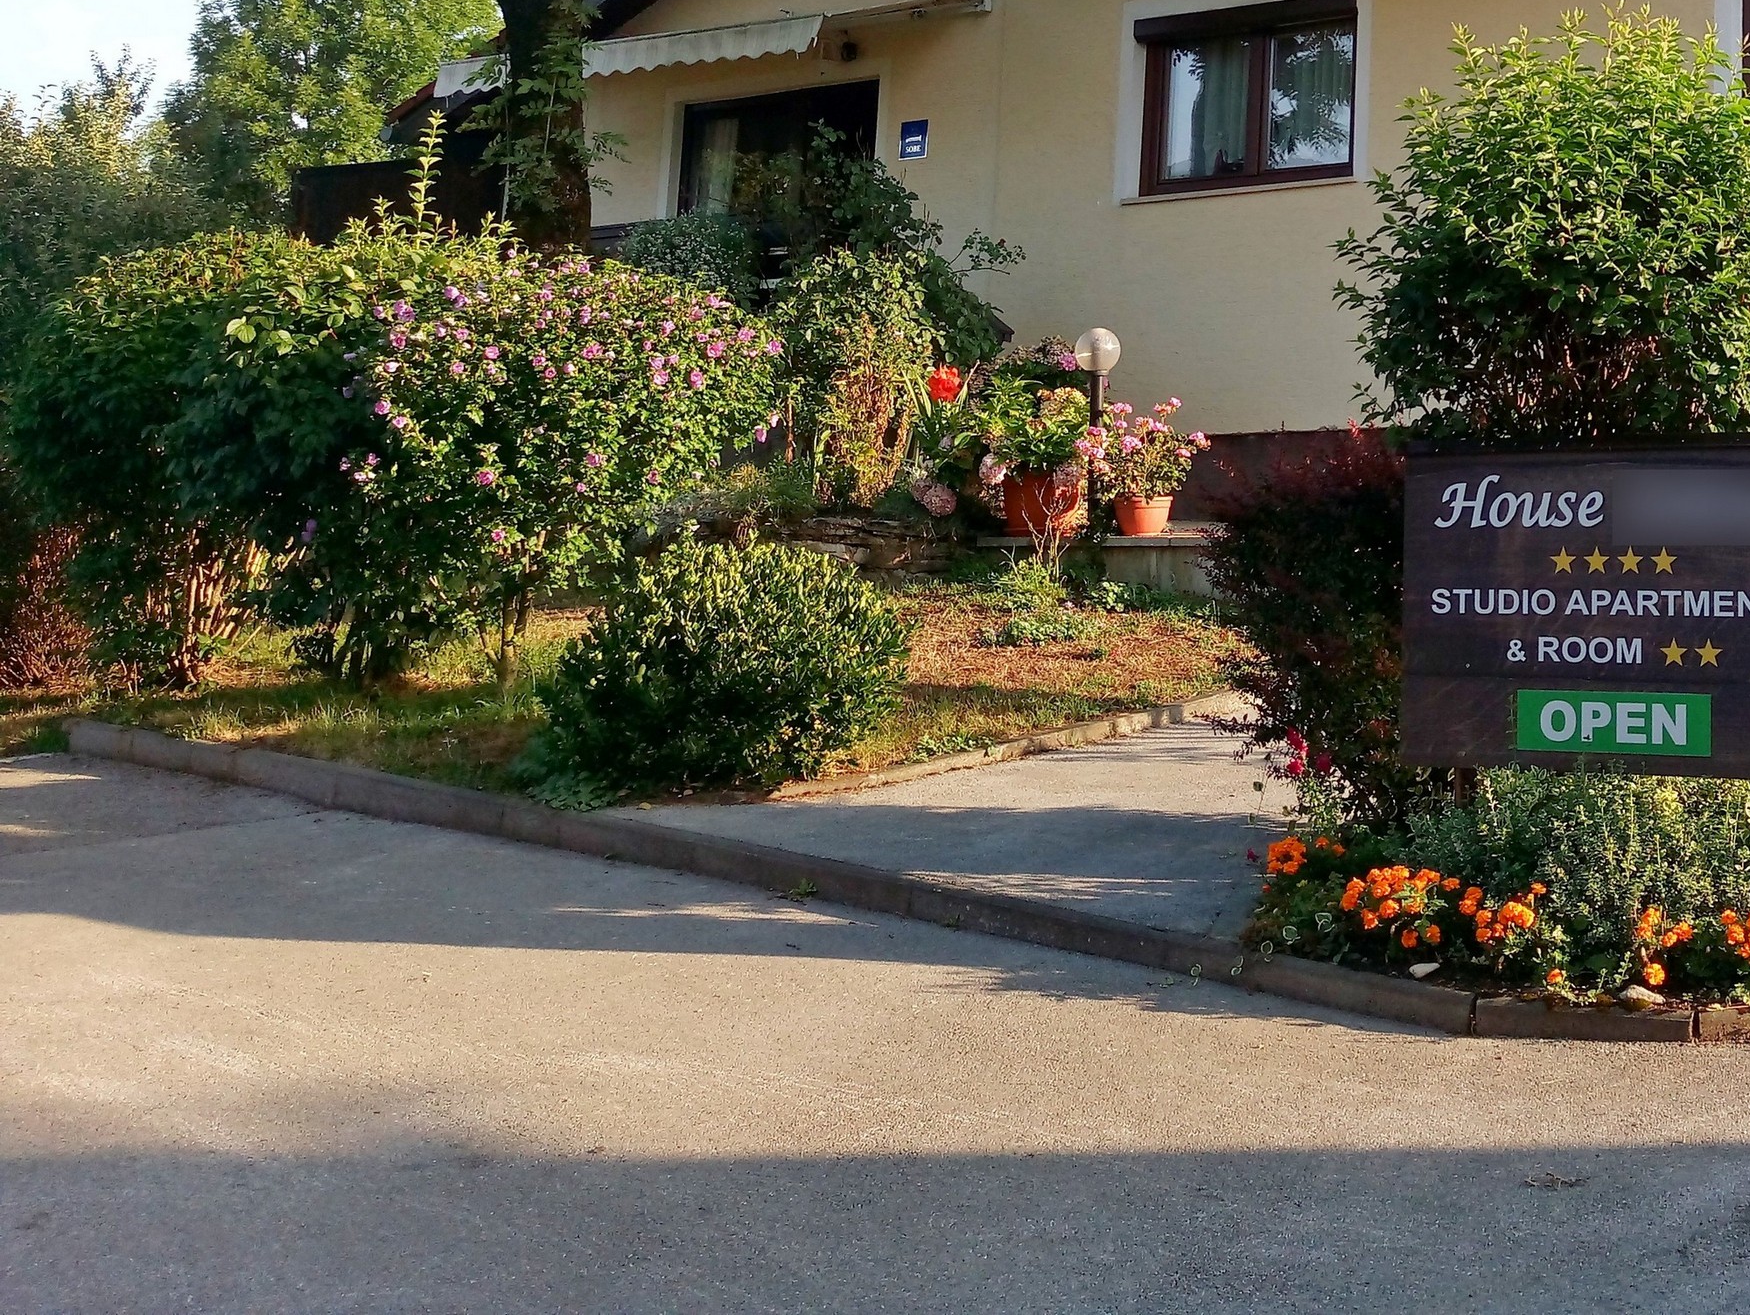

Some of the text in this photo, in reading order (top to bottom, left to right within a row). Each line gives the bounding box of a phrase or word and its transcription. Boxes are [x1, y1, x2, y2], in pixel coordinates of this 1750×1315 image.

[1433, 474, 1604, 529] House
[1431, 588, 1556, 615] STUDIO
[1507, 636, 1642, 664] & ROOM
[1539, 699, 1688, 746] OPEN
